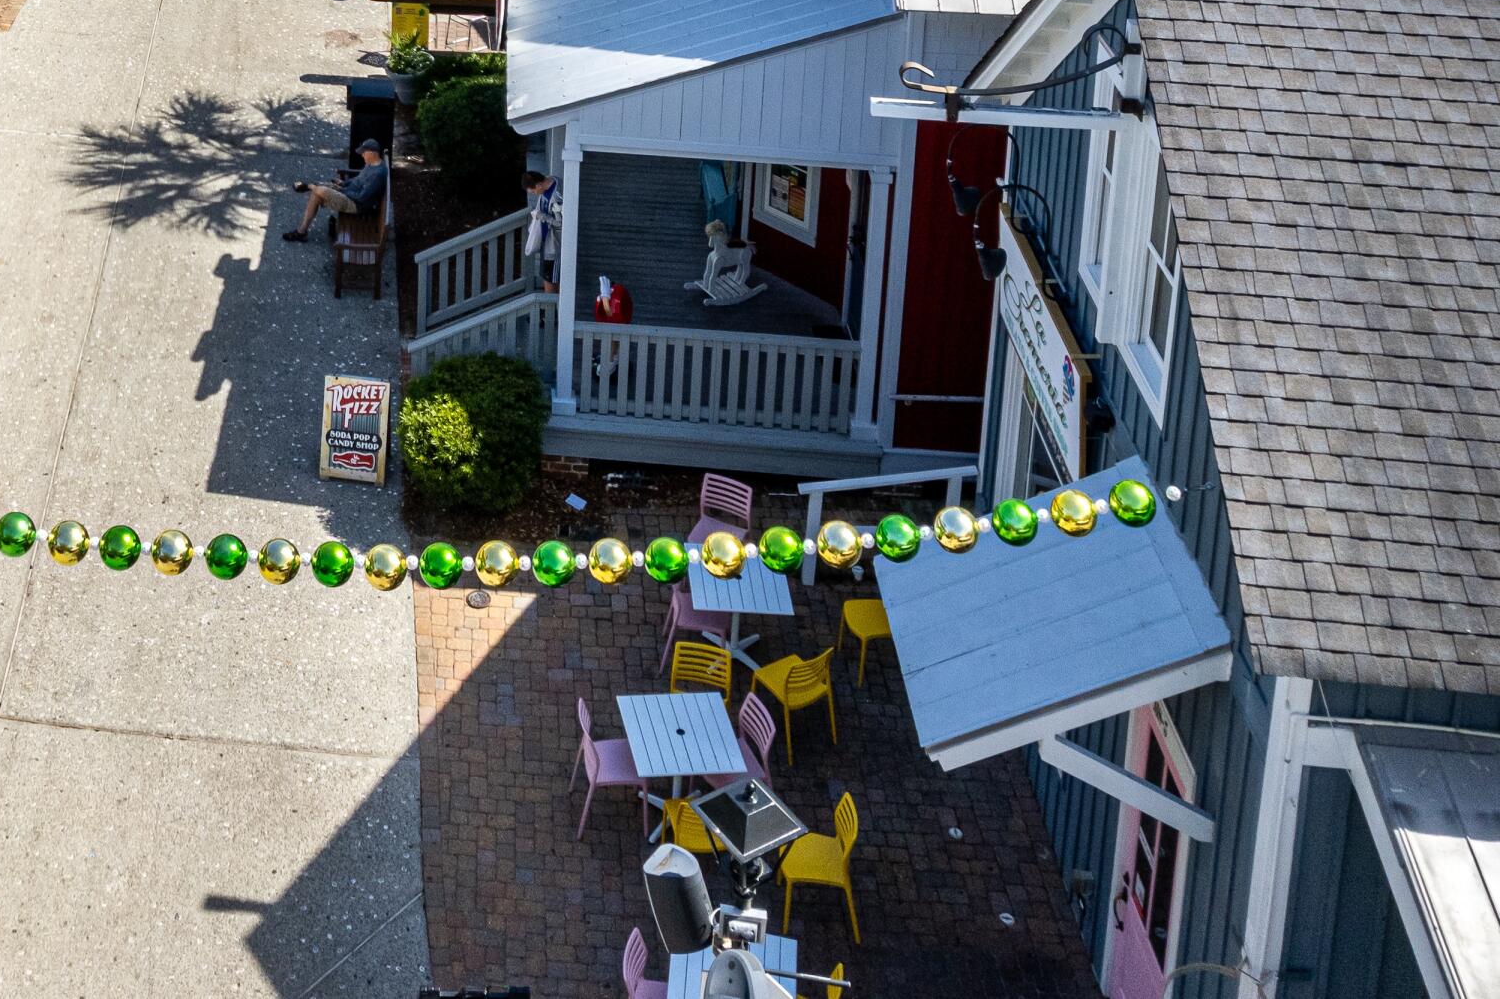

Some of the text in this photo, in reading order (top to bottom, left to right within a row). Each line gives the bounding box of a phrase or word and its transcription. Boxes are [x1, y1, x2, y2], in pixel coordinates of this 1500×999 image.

[327, 385, 385, 412] ROCKET
[340, 402, 381, 428] FIZZ
[328, 438, 379, 450] CANDY SHOP
[330, 431, 351, 439] SODA
[353, 433, 370, 441] POP
